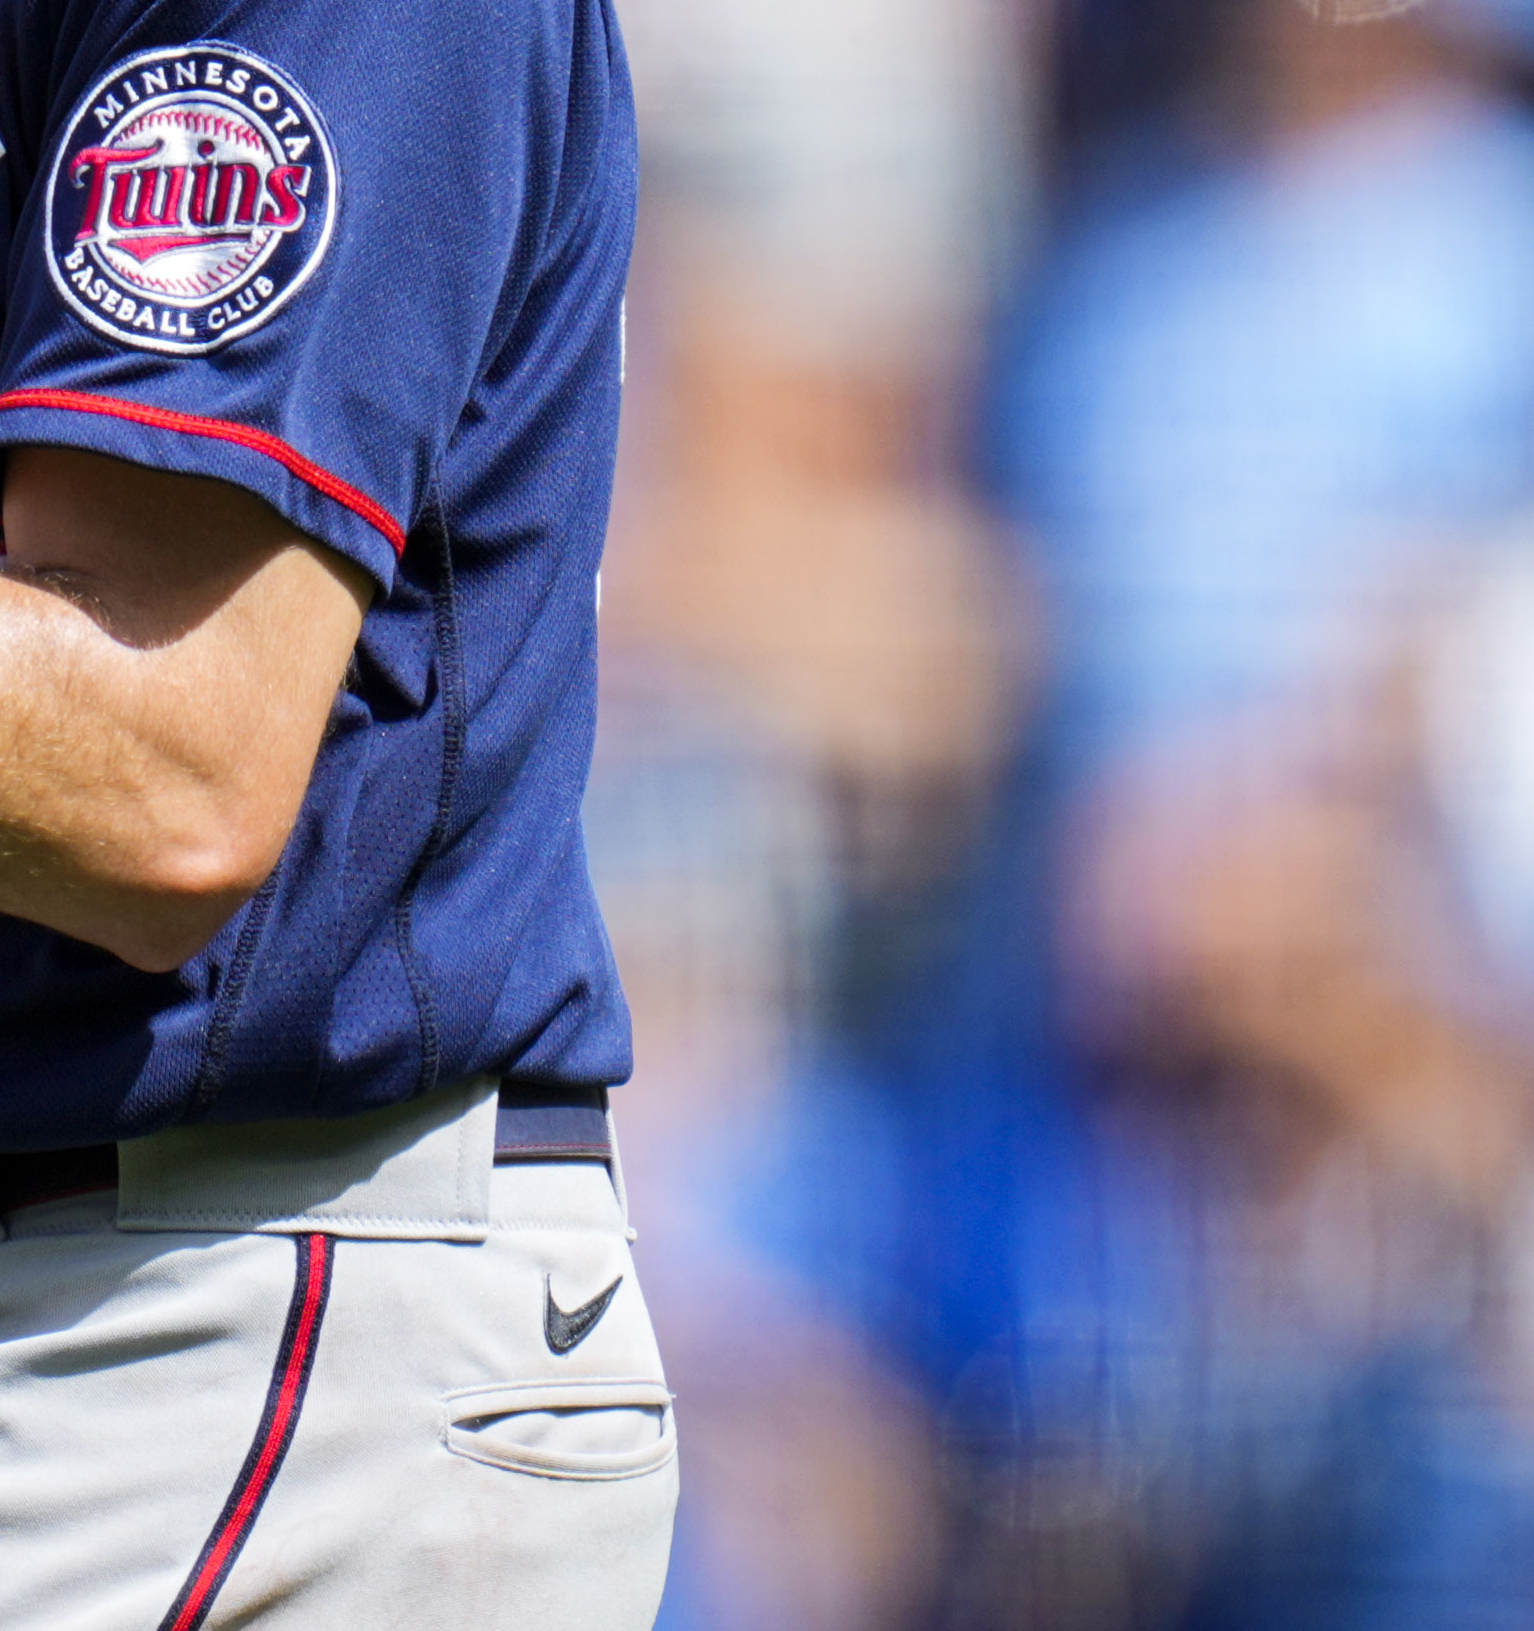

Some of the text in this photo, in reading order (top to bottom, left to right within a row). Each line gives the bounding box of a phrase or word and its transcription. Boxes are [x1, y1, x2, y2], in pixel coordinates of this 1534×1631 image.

[93, 60, 311, 160] MINNESOTA
[67, 135, 312, 247] Twins
[64, 248, 274, 337] BASEBALL CLUB
